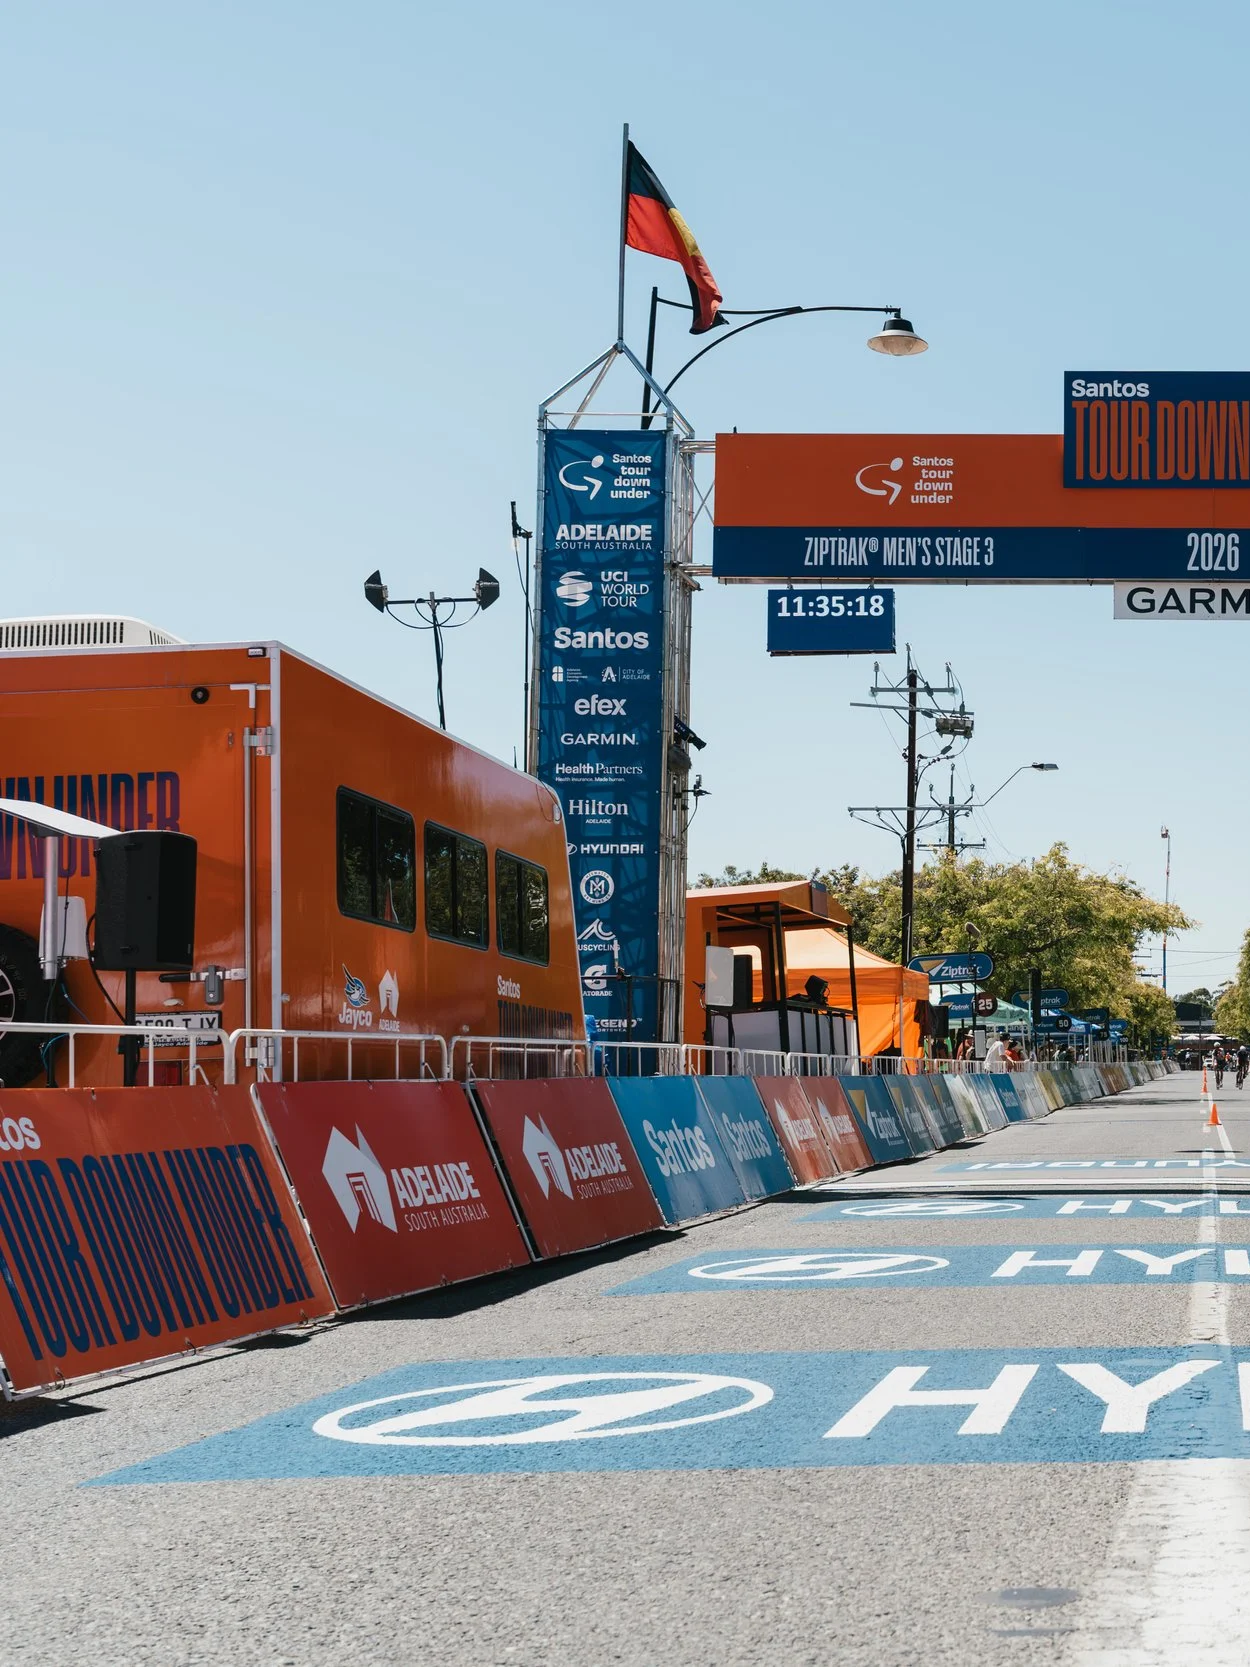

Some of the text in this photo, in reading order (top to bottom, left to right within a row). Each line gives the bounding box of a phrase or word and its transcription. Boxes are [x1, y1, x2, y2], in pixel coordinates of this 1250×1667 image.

[1072, 380, 1149, 397] Santos
[1072, 400, 1150, 480] TOUR
[1156, 400, 1250, 480] DOWN
[612, 454, 652, 464] Santos
[912, 456, 954, 467] Santos
[621, 465, 651, 476] tour
[922, 469, 953, 479] tour
[614, 476, 651, 487] down
[914, 480, 953, 490] down
[610, 488, 651, 499] under
[910, 493, 953, 504] under
[555, 524, 652, 541] ADELAIDE
[555, 542, 652, 550] SOUTH AUSTRALIA
[883, 537, 931, 566] MEN’S
[935, 537, 980, 566] STAGE
[984, 537, 994, 566] 3
[1187, 533, 1240, 571] 2026
[601, 571, 628, 582] UCI
[601, 584, 650, 595] WORLD
[601, 596, 638, 608] TOUR
[777, 595, 885, 617] 11:35:18
[554, 627, 650, 649] Santos
[574, 694, 627, 716] efex
[569, 800, 628, 816] Hilton
[581, 844, 644, 854] HYUNDAI
[497, 975, 520, 999] Santos
[978, 999, 993, 1010] 25
[1041, 997, 1061, 1006] ptrak
[339, 1002, 372, 1030] Jayco
[1059, 1020, 1068, 1028] 50
[722, 1112, 772, 1162] Santos
[643, 1118, 716, 1177] Santos
[563, 1142, 627, 1181] ADELAIDE
[390, 1162, 480, 1208] ADELAIDE
[577, 1176, 634, 1200] SOUTH AUSTRALIA
[404, 1203, 489, 1232] SOUTH AUSTRALIA
[56, 1151, 219, 1342] DOWN
[163, 1143, 315, 1318] UNDER
